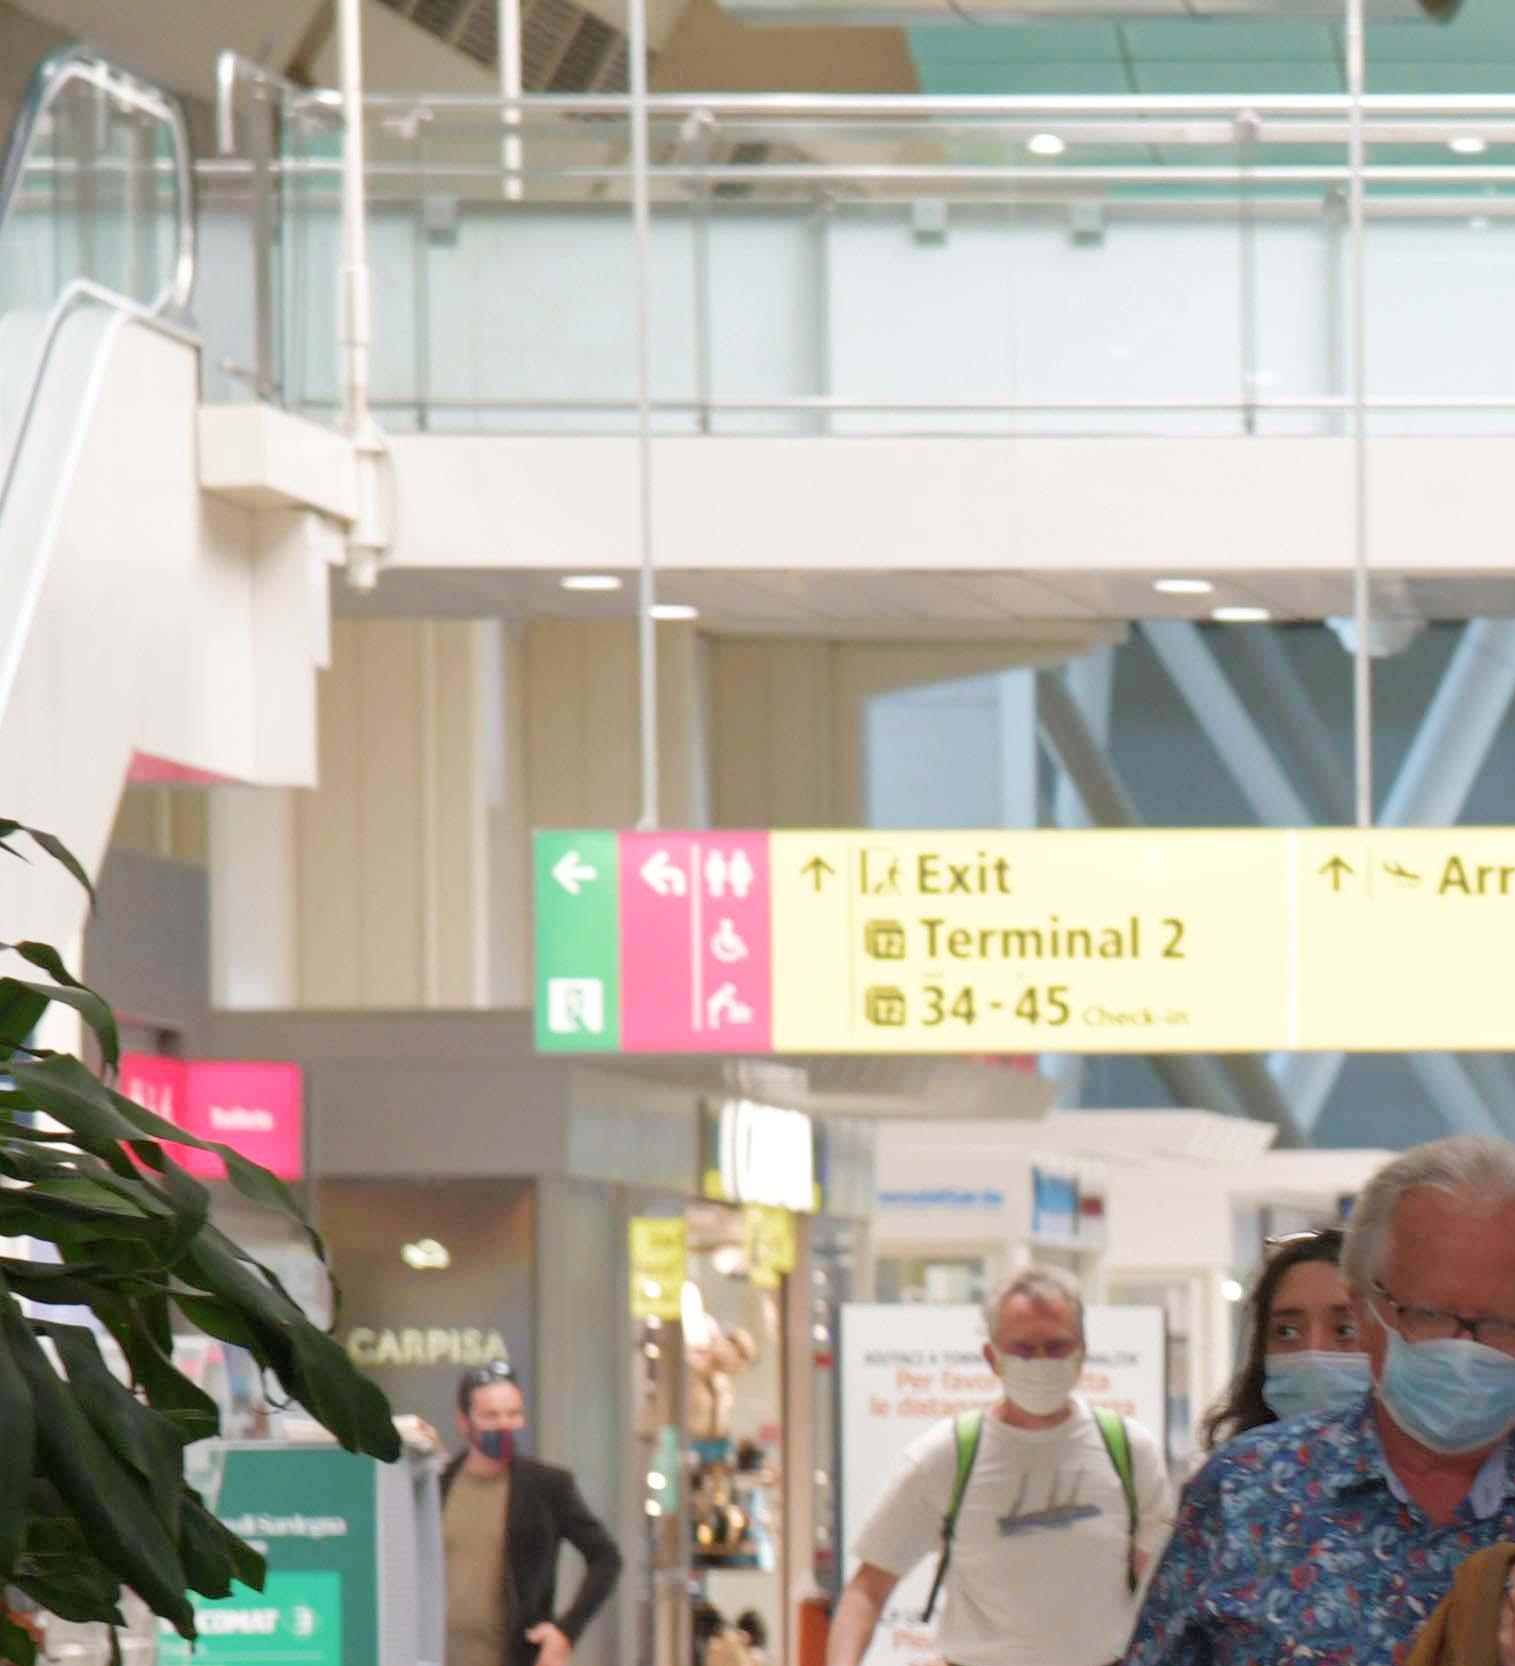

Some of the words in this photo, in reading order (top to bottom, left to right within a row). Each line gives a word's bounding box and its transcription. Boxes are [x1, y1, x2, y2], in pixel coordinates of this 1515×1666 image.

[917, 851, 1010, 894] Exit
[919, 916, 1139, 959] Terminal
[1161, 917, 1187, 959] 2
[921, 985, 977, 1026] 34
[1014, 985, 1070, 1026] 45
[349, 1327, 509, 1367] CARPISA
[896, 1370, 931, 1389] Per
